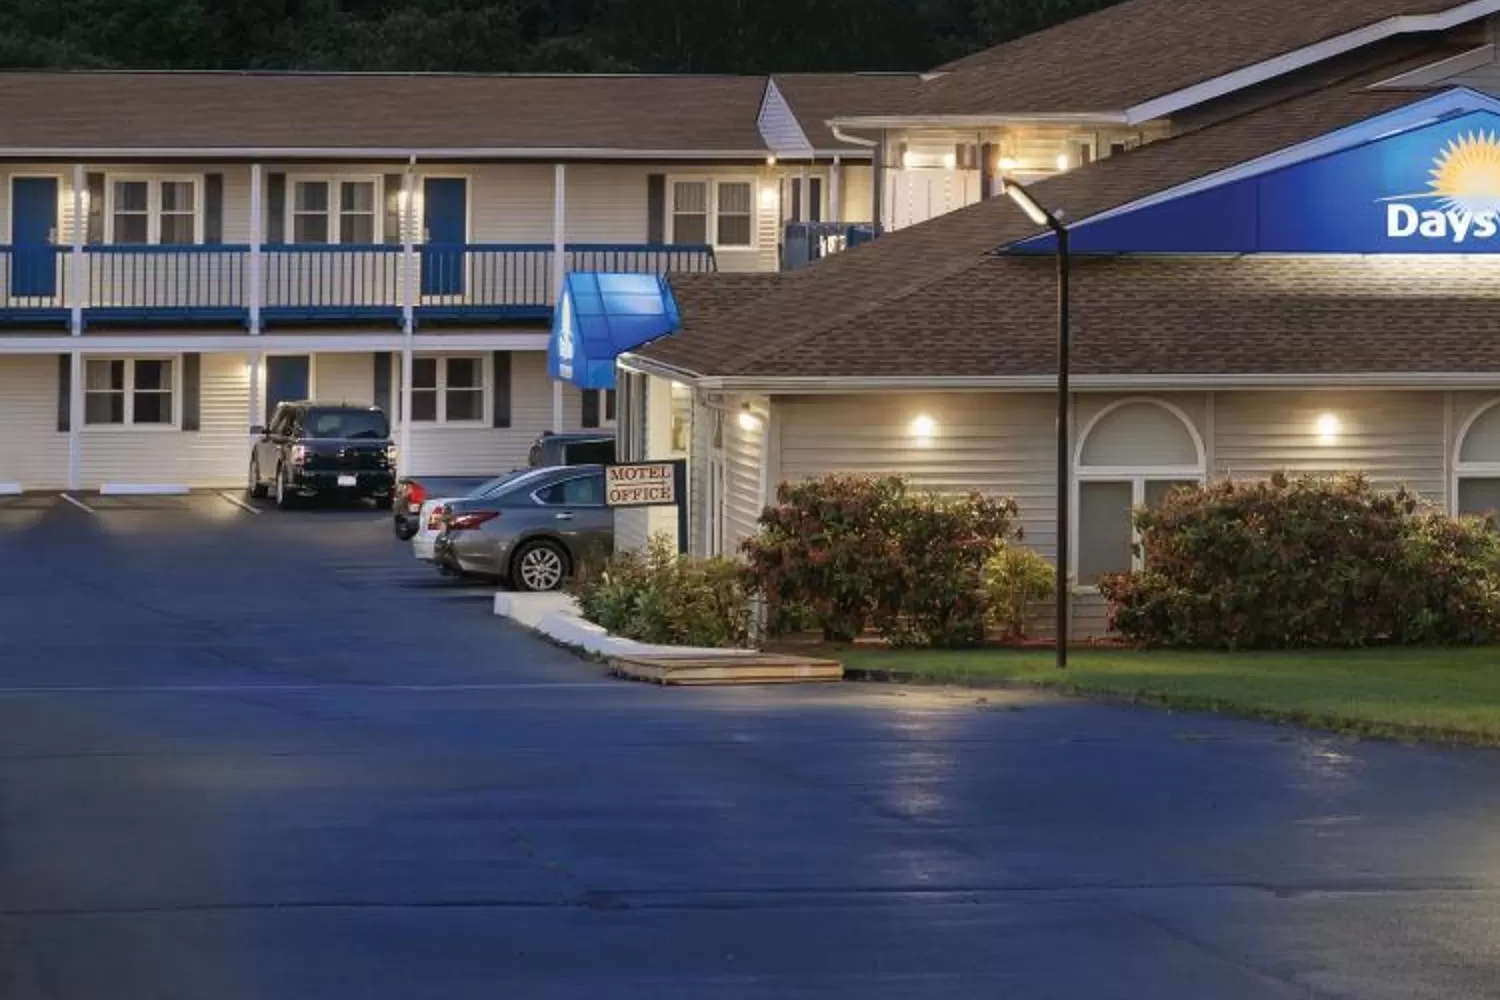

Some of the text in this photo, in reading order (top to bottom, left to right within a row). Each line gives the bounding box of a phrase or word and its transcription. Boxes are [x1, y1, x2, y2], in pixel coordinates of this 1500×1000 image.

[1387, 203, 1497, 243] Days
[610, 465, 671, 480] MOTEL
[609, 487, 671, 502] OFFICE
